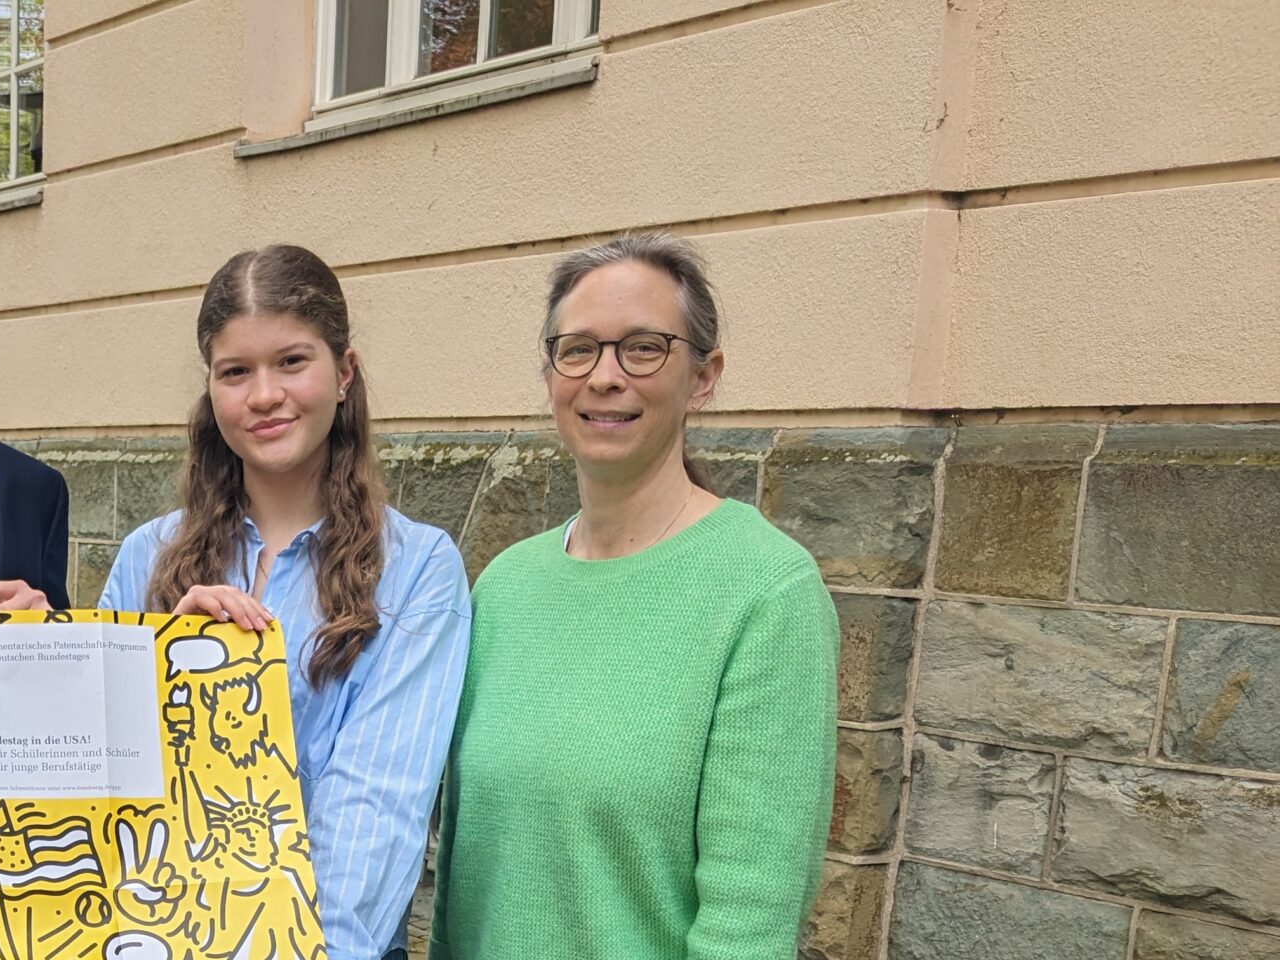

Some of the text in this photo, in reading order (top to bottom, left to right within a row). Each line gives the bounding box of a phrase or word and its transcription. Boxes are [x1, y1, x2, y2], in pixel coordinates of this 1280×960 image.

[53, 640, 148, 652] Patenschafts-Programm
[37, 652, 90, 662] Bundestages
[31, 735, 41, 745] in
[44, 735, 61, 745] die
[63, 735, 91, 744] USA!
[10, 748, 79, 758] Schülerinnen
[82, 747, 102, 757] und
[105, 747, 140, 758] Schüler
[11, 762, 38, 773] junge
[41, 762, 102, 773] Berufstätige
